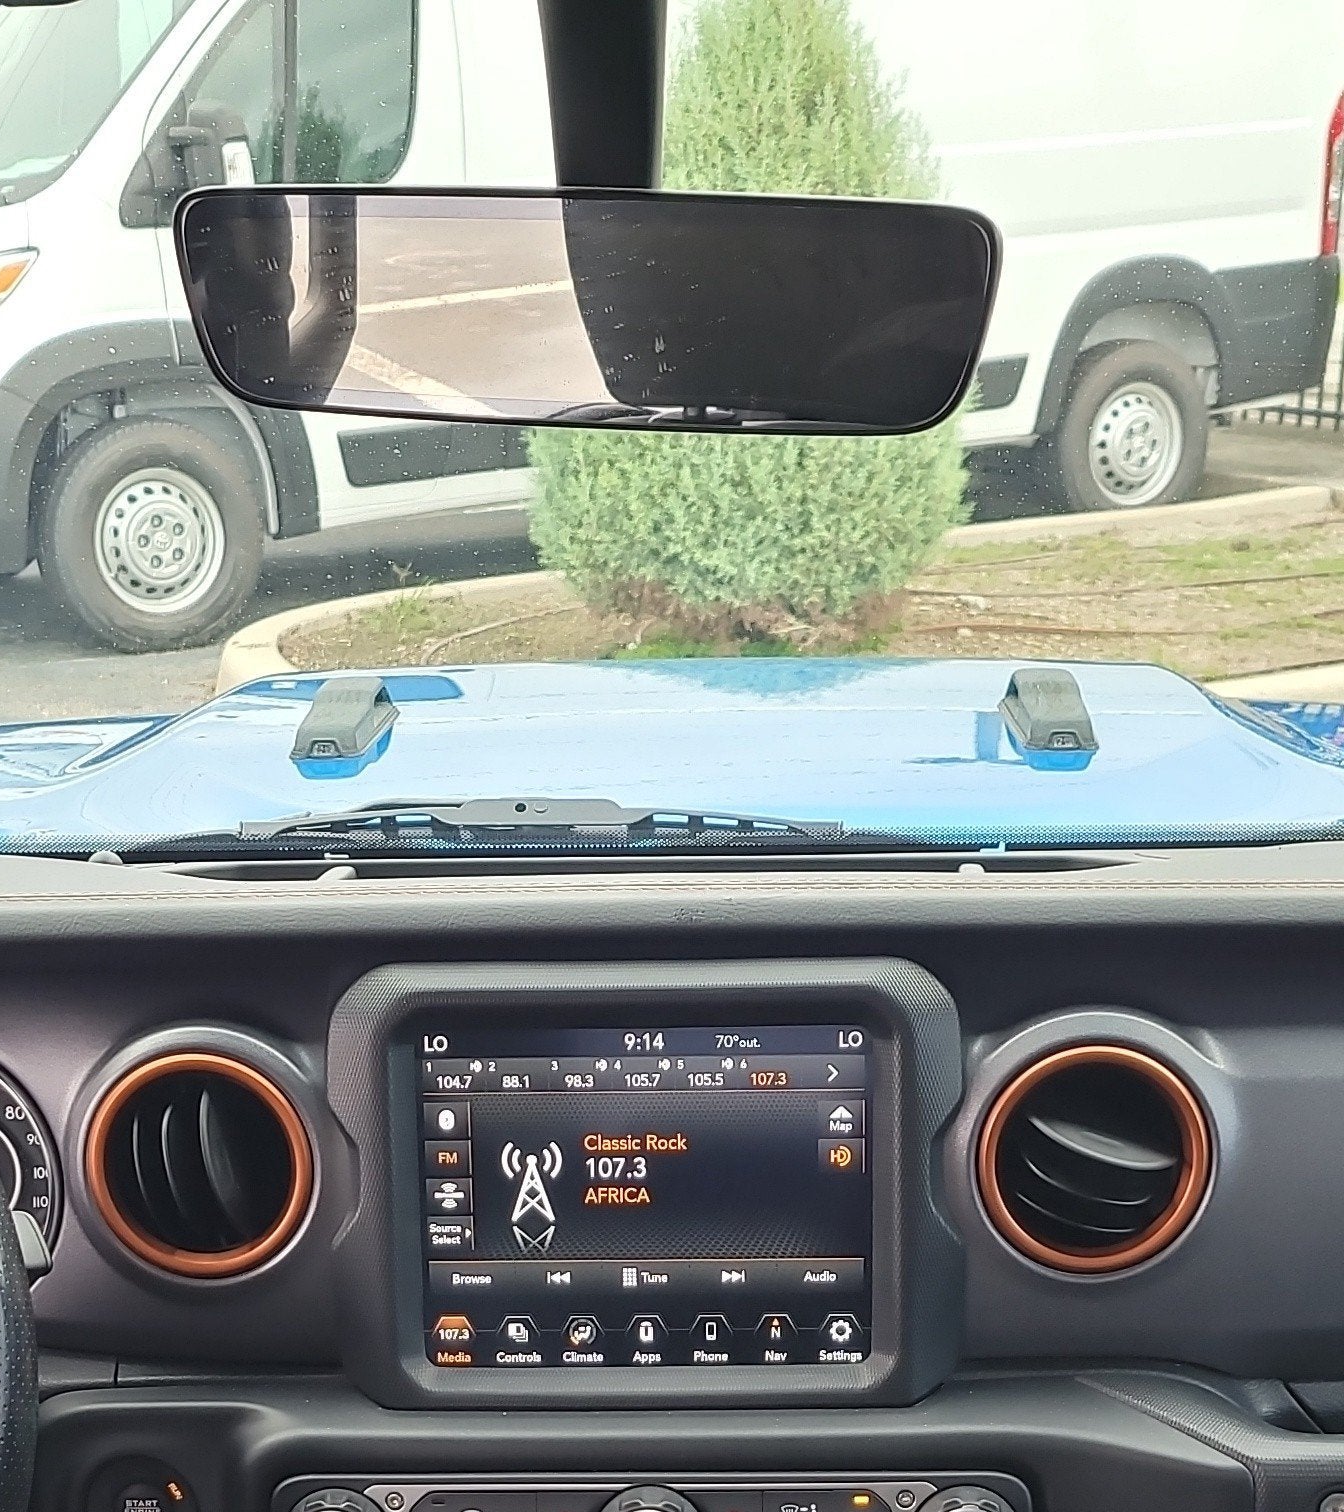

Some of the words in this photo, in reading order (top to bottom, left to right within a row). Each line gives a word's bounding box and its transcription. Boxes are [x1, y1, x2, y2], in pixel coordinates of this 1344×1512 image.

[423, 1035, 449, 1053] LO
[623, 1032, 665, 1051] 9:14
[838, 1030, 863, 1048] LO
[425, 1061, 433, 1073] 1
[488, 1060, 497, 1072] 2
[551, 1060, 559, 1071] 3
[613, 1059, 623, 1071] 4
[676, 1059, 685, 1070] 5
[739, 1058, 748, 1070] 6
[436, 1074, 473, 1089] 104.7
[502, 1074, 530, 1089] 88.1
[564, 1074, 594, 1088] 98.3
[624, 1073, 662, 1088] 105.7
[687, 1072, 724, 1087] 105.5
[750, 1072, 787, 1086] 107.3
[5, 1106, 26, 1121] 80
[829, 1118, 853, 1133] Map
[584, 1133, 640, 1152] Classic
[645, 1133, 688, 1152] Rock
[438, 1151, 458, 1165] FM
[586, 1158, 647, 1178] 107.3
[32, 1196, 49, 1208] 110
[585, 1187, 651, 1205] AFRICA
[429, 1223, 462, 1235] Source
[431, 1233, 462, 1245] Select
[452, 1273, 492, 1285] Browse
[641, 1272, 668, 1284] Tune
[803, 1270, 837, 1283] Audio
[438, 1327, 470, 1340] 107.3
[437, 1351, 472, 1364] Media
[496, 1351, 542, 1364] Controls
[562, 1350, 604, 1364] Climate
[632, 1350, 661, 1365] Apps
[693, 1350, 729, 1363] Phone
[764, 1349, 788, 1362] Nav
[819, 1348, 863, 1364] Settings
[125, 1499, 158, 1508] START
